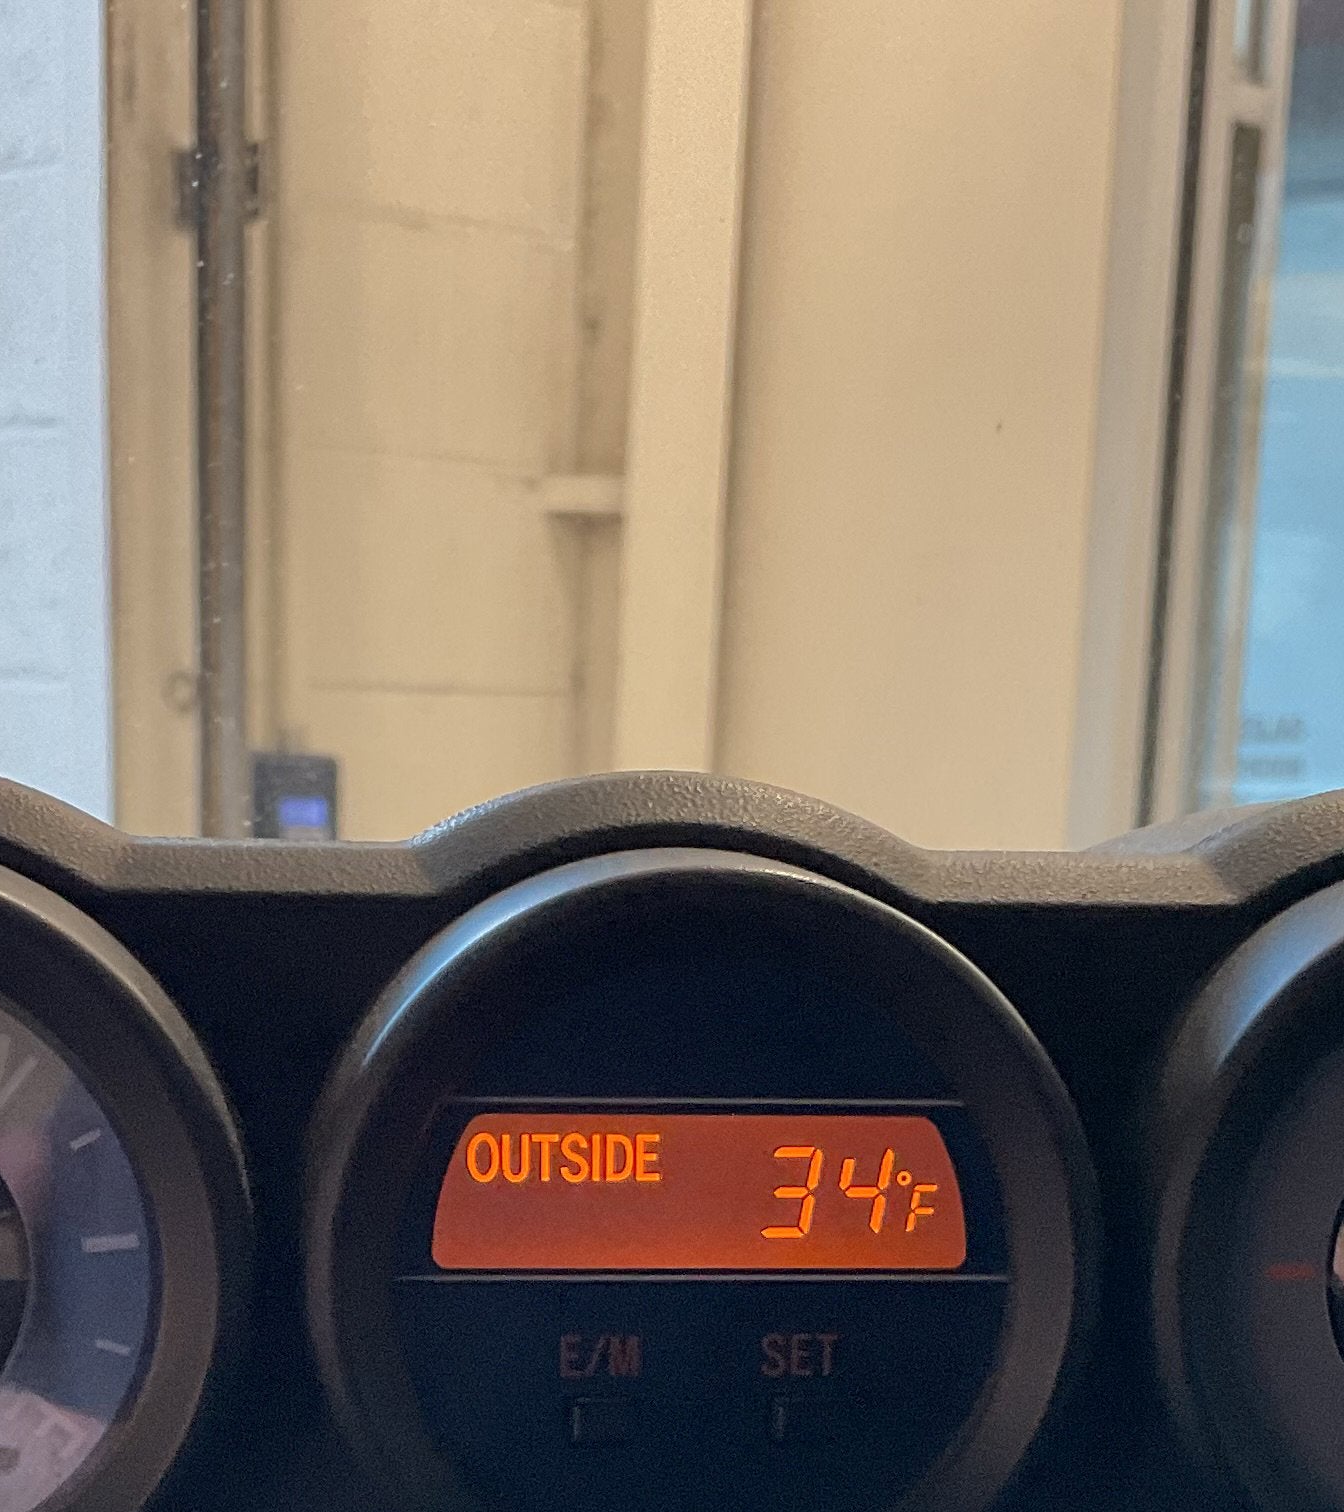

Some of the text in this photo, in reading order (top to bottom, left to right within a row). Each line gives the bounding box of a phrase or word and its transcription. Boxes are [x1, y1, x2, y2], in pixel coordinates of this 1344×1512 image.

[465, 1132, 662, 1184] OUTSIDE
[559, 1333, 643, 1379] E/M
[759, 1332, 846, 1378] SET
